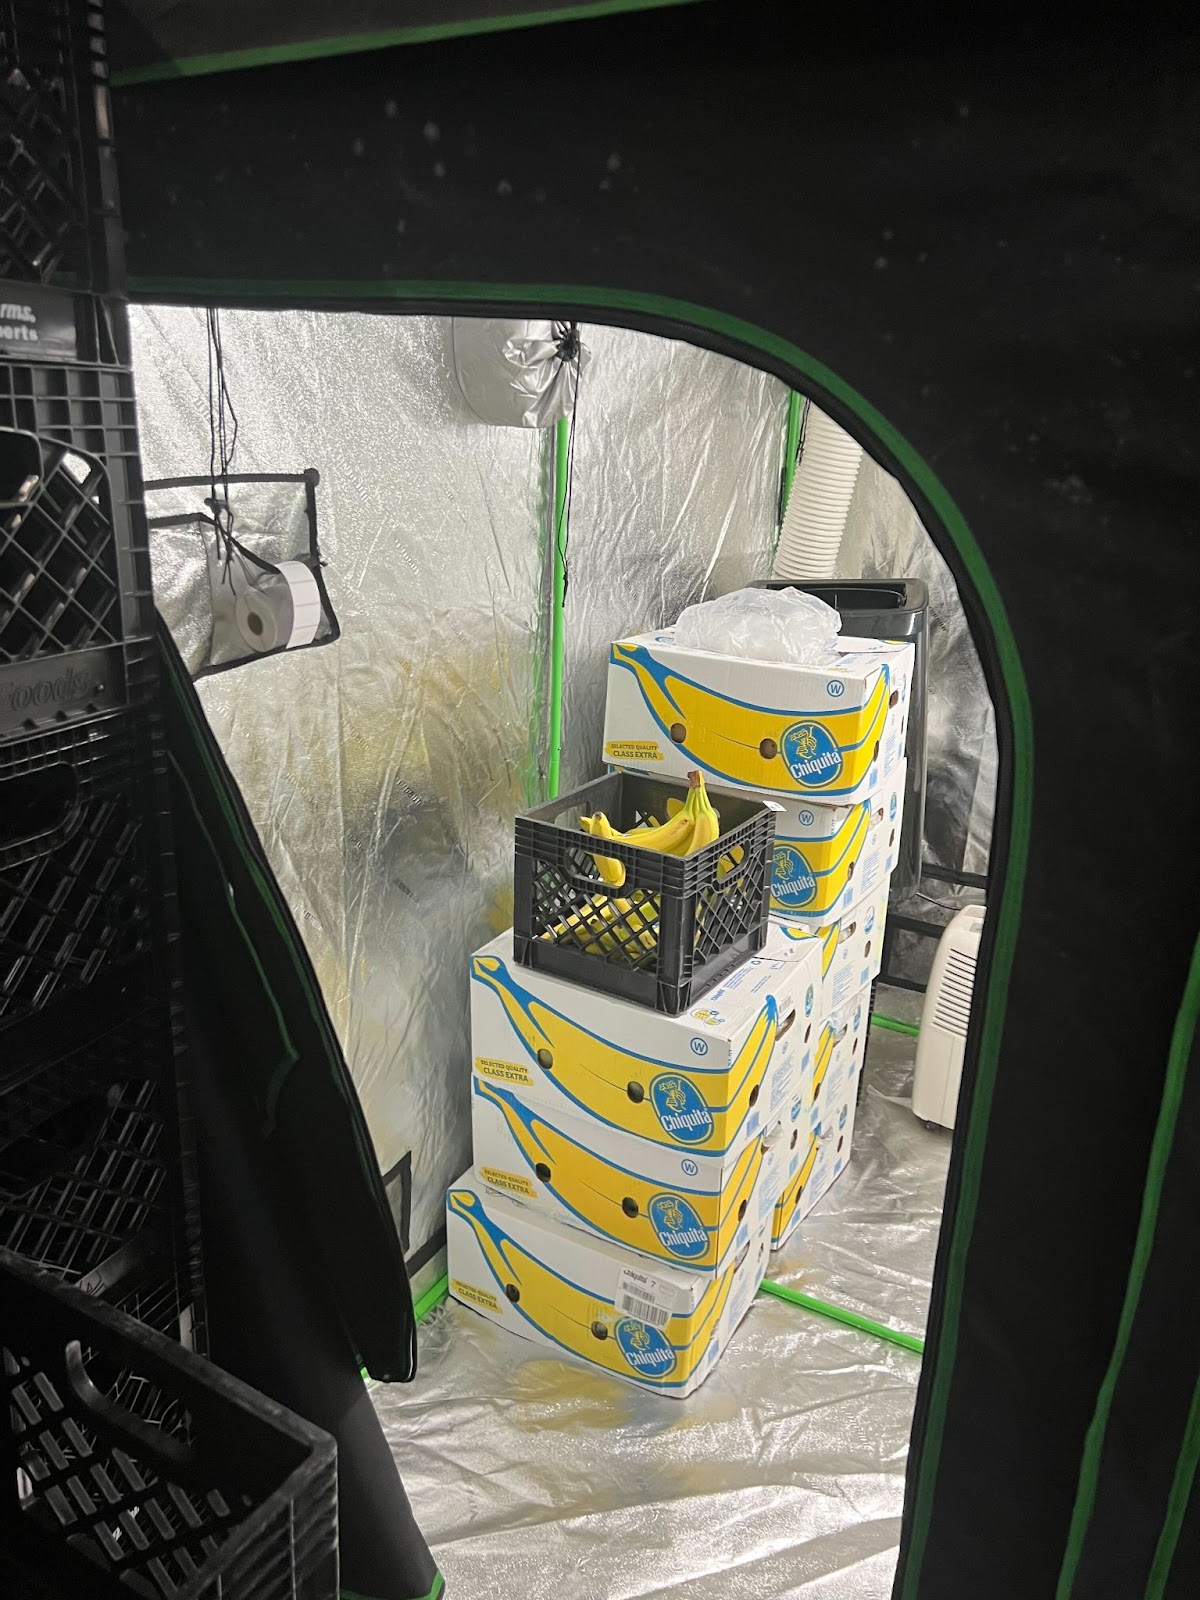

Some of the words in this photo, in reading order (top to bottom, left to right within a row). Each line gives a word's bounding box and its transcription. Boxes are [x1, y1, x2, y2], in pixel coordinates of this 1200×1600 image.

[790, 750, 842, 779] Chiquita
[771, 875, 816, 898] Chiquita
[480, 1059, 505, 1069] SELECTED
[505, 1065, 528, 1073] QUALITY
[483, 1067, 504, 1077] CLASS
[505, 1071, 529, 1082] EXTRA
[661, 1109, 712, 1132] Chiquita
[487, 1176, 507, 1187] CLASS
[508, 1183, 530, 1195] EXTRA
[658, 1228, 708, 1248] Chiquita
[625, 1348, 675, 1367] Chiquita
